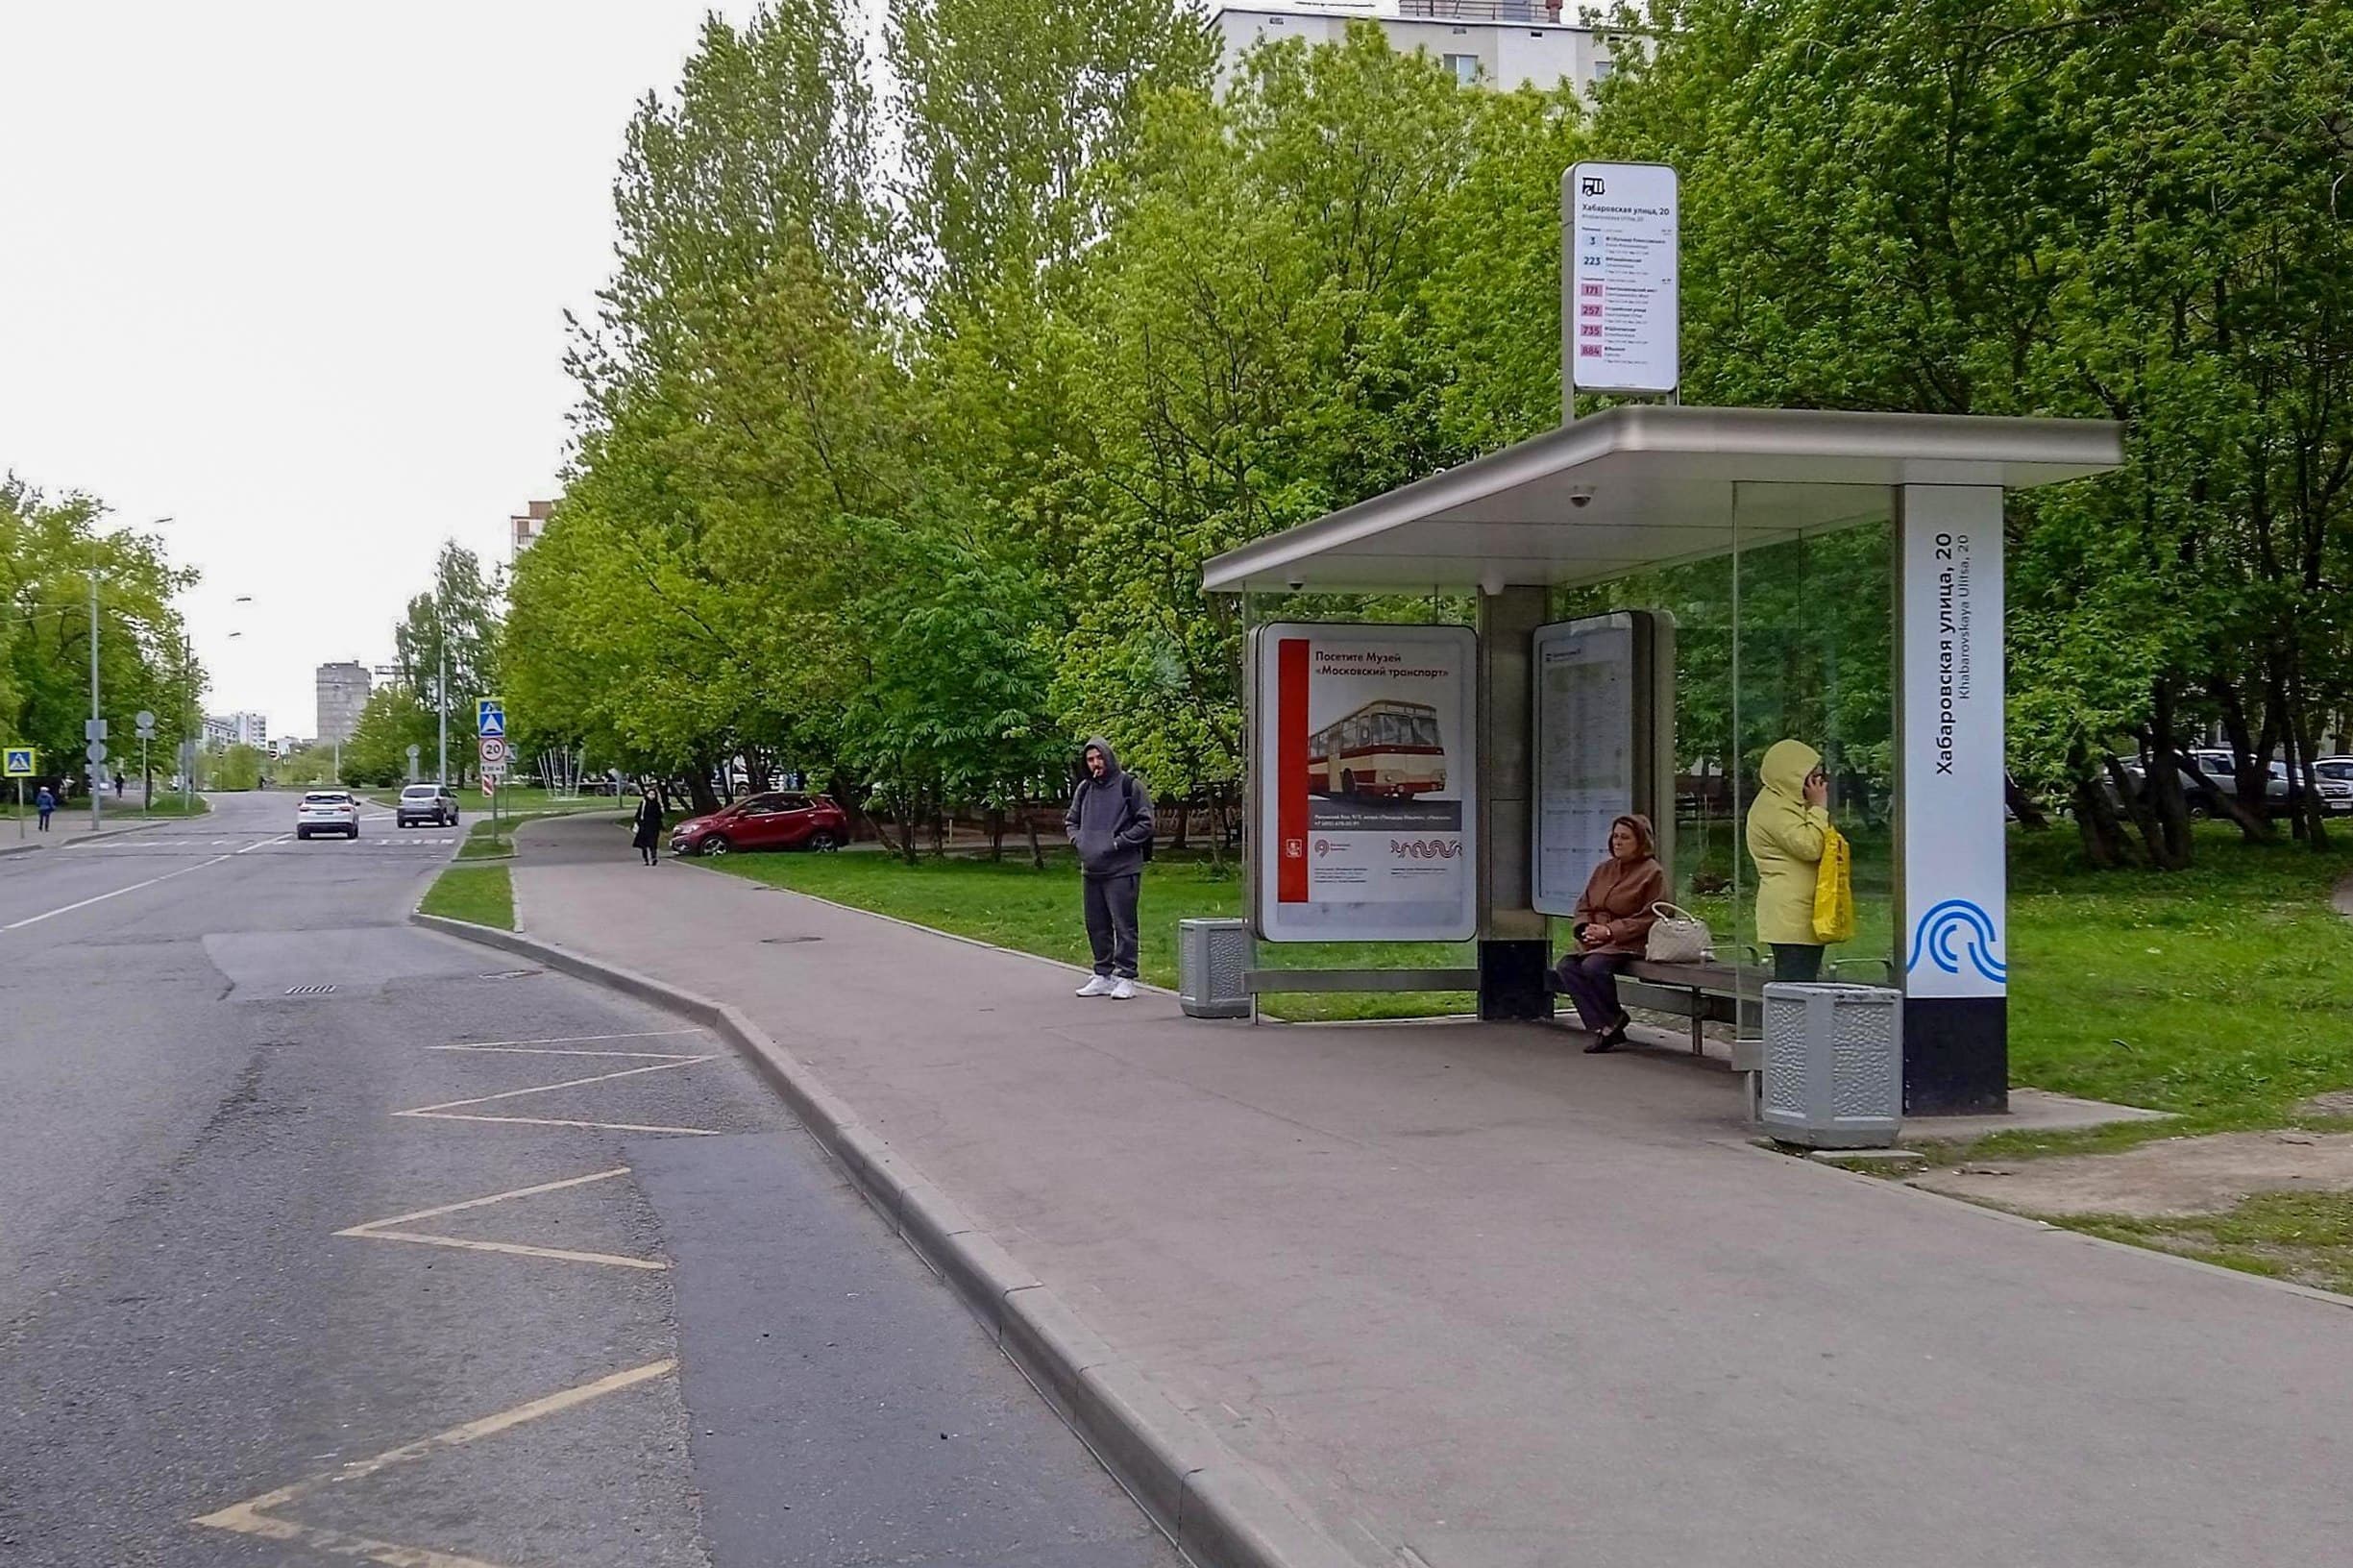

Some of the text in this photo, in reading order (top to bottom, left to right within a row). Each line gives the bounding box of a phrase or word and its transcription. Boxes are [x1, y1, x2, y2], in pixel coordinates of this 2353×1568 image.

[1581, 204, 1631, 213] Хабаровская
[1658, 208, 1670, 216] 20
[1589, 236, 1596, 245] 3
[1583, 257, 1601, 266] 223
[1585, 285, 1599, 295] 171
[1583, 306, 1600, 316] 257
[1583, 326, 1600, 336] 735
[1958, 535, 1972, 699] Khabarovskaya Ulitsa, 20
[1315, 650, 1402, 664] Посетите Музей
[1936, 532, 1956, 775] Хабаровская улица, 20
[1315, 665, 1449, 679] «Московский транспорт»
[485, 744, 501, 754] 20
